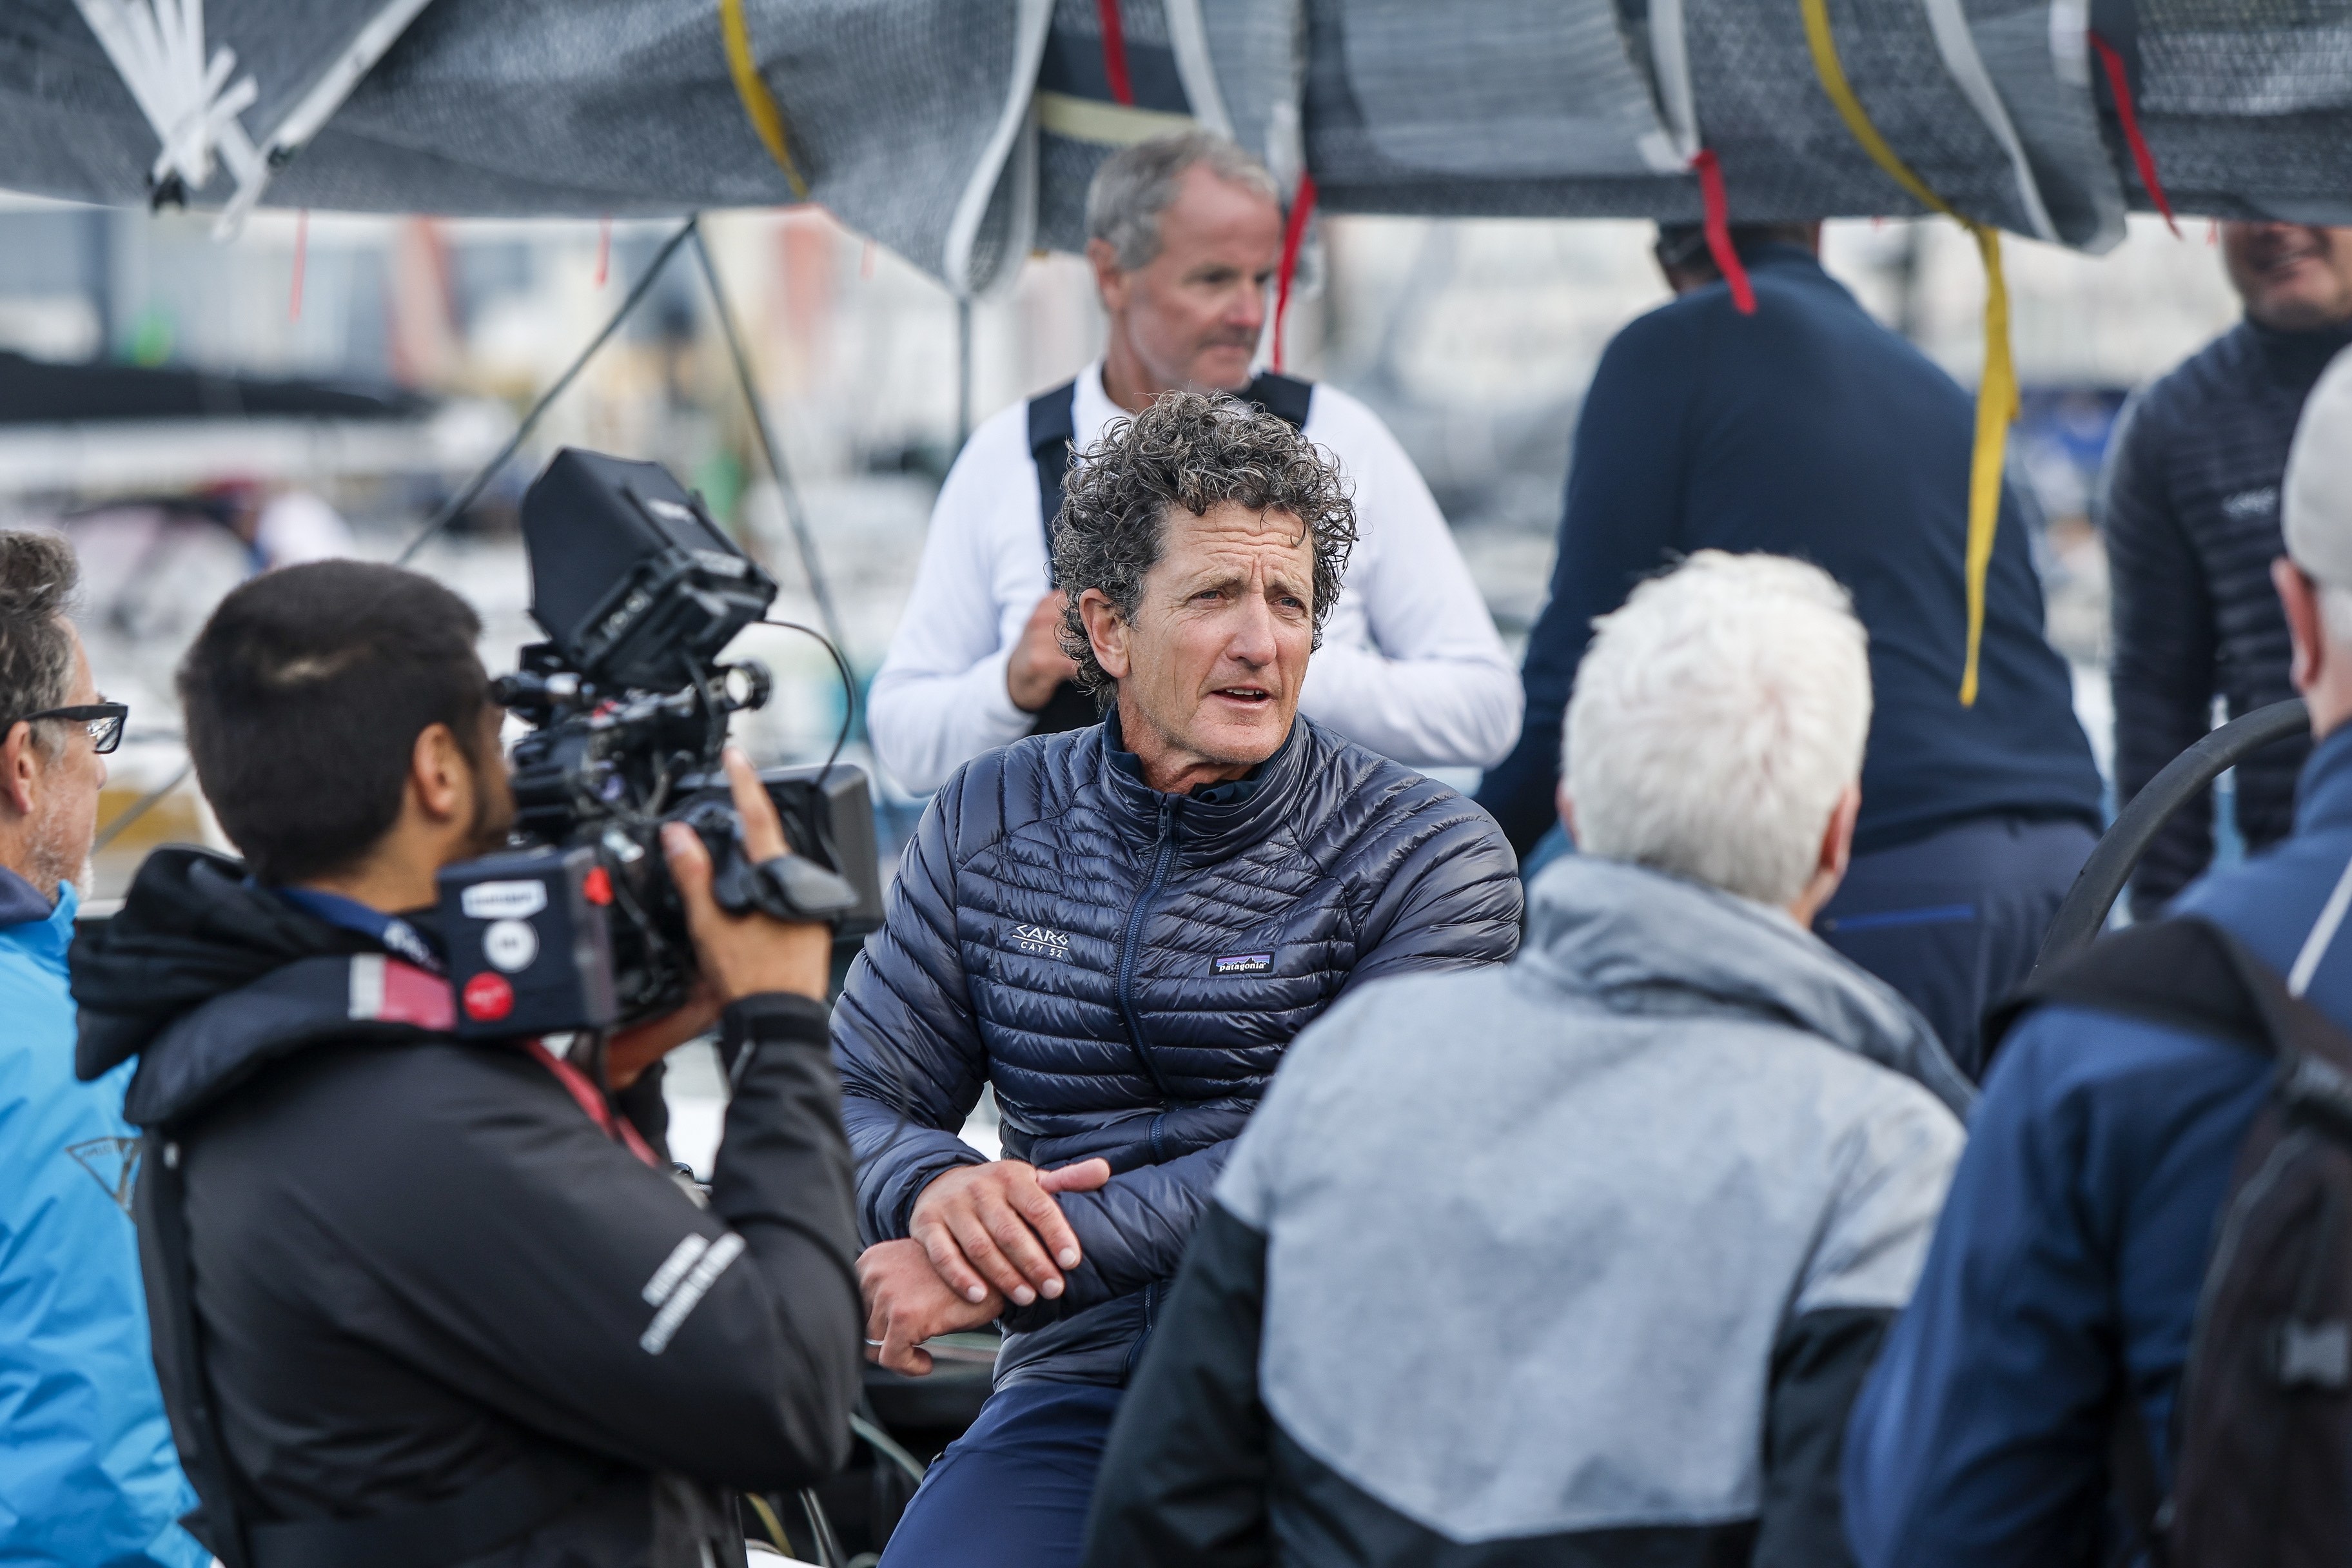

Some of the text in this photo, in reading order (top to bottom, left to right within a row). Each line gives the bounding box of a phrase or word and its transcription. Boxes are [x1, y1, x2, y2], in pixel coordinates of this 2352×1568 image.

[1015, 924, 1068, 946] CARO
[1020, 941, 1062, 958] CAY 52
[1219, 962, 1265, 972] patagonia
